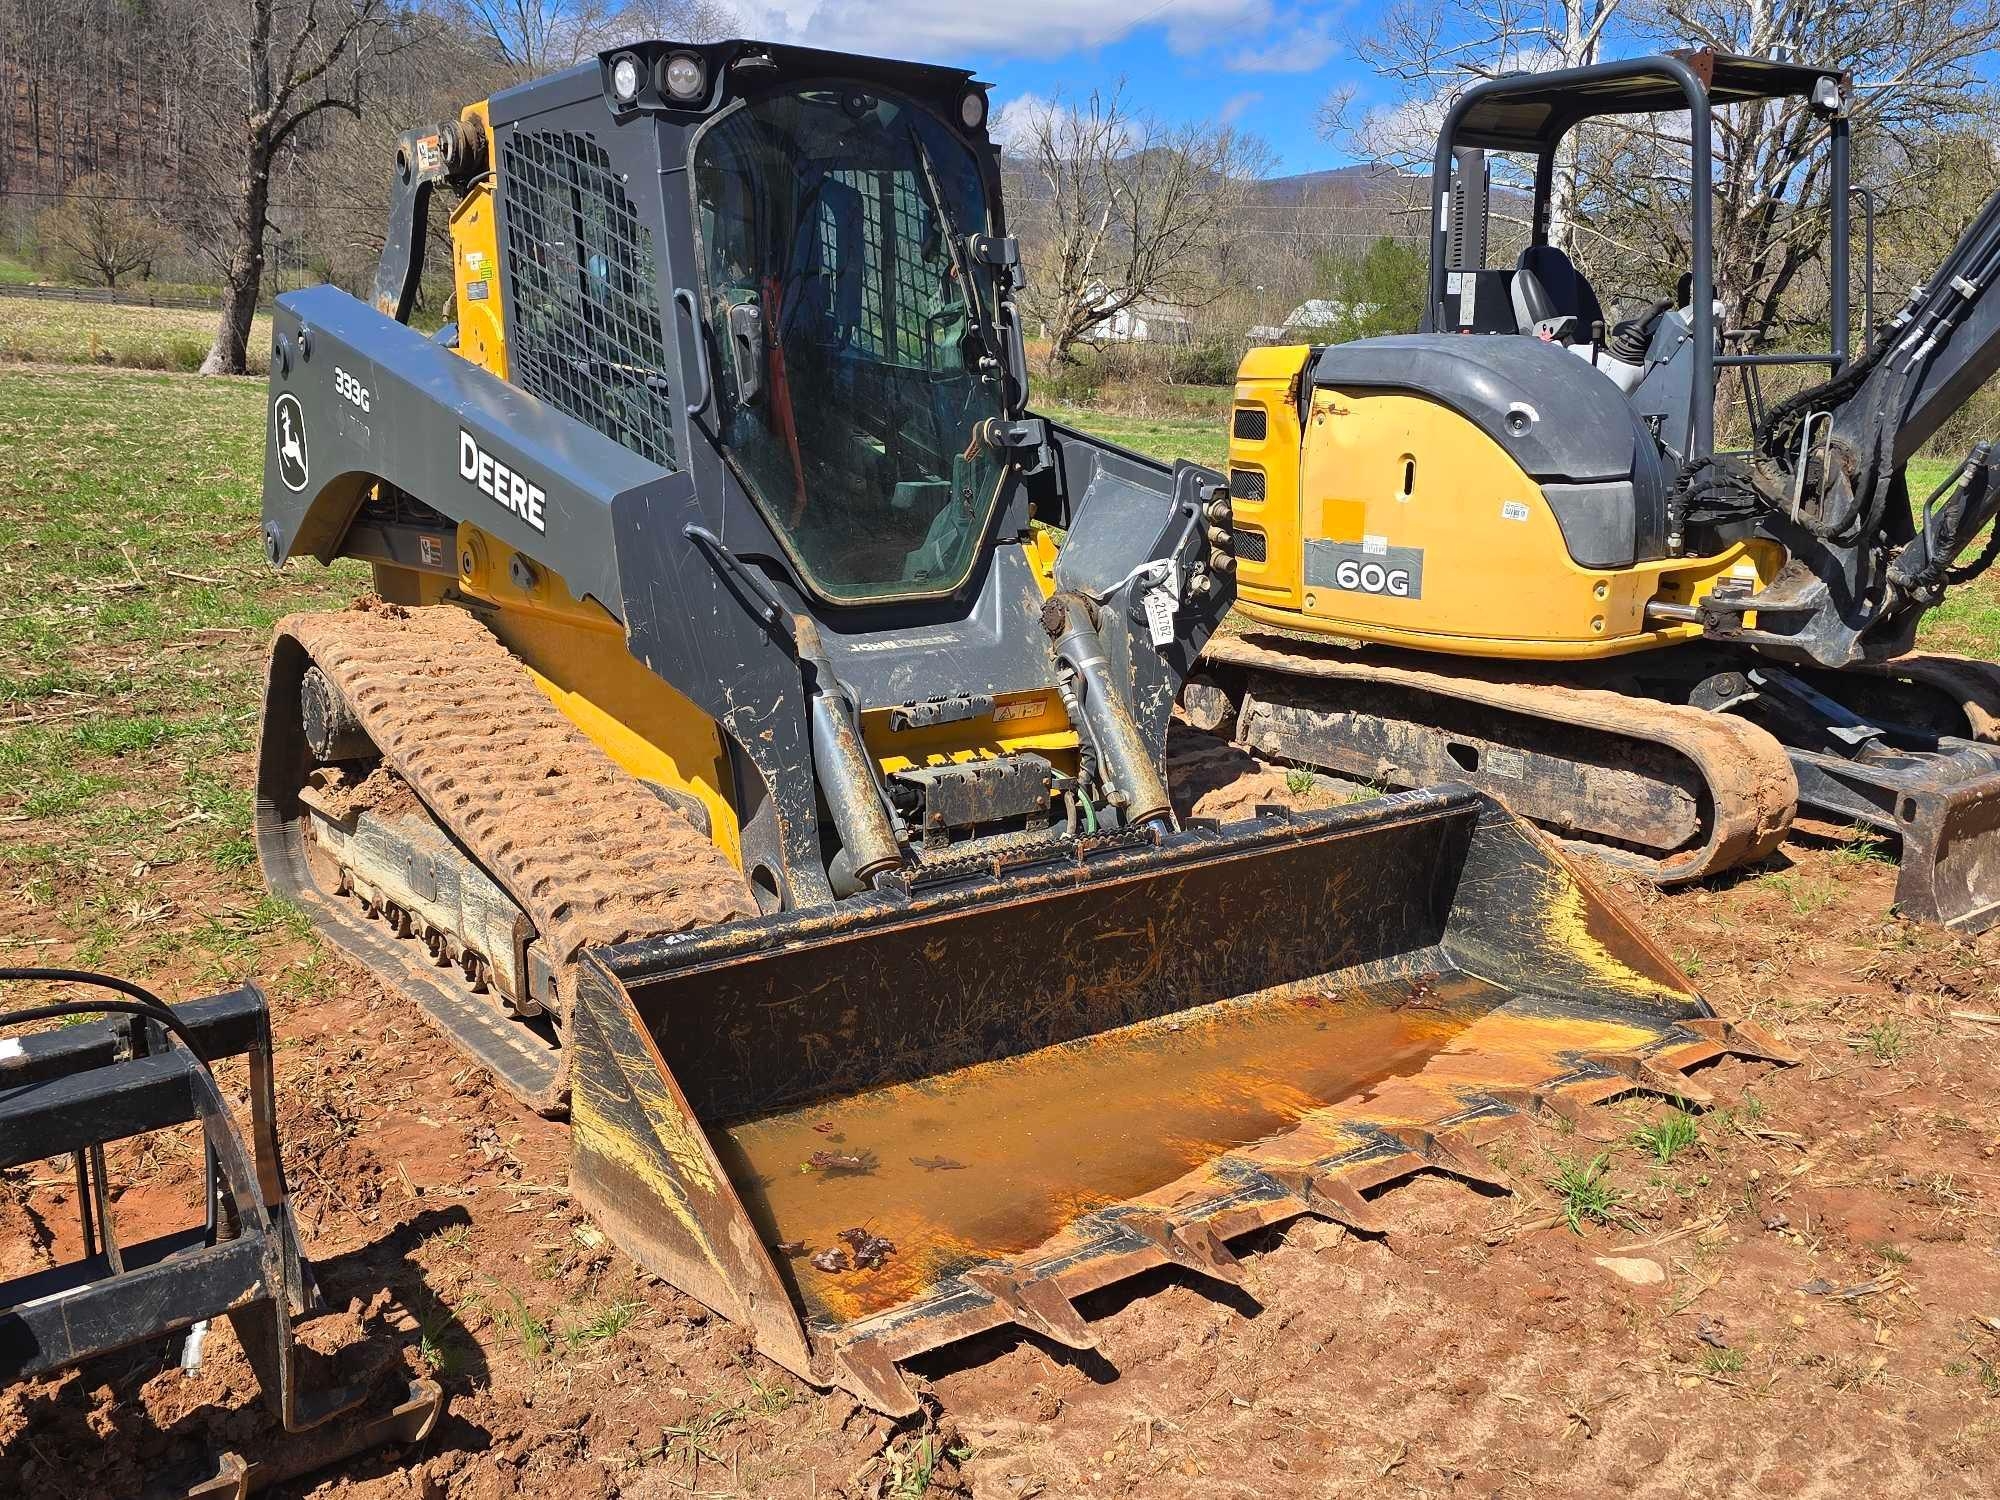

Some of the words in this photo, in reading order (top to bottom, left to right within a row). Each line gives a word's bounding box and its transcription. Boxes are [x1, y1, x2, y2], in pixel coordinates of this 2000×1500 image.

[334, 365, 370, 414] 333G
[459, 427, 546, 535] DEERE
[1336, 559, 1409, 597] 60G
[1154, 602, 1172, 637] 211762
